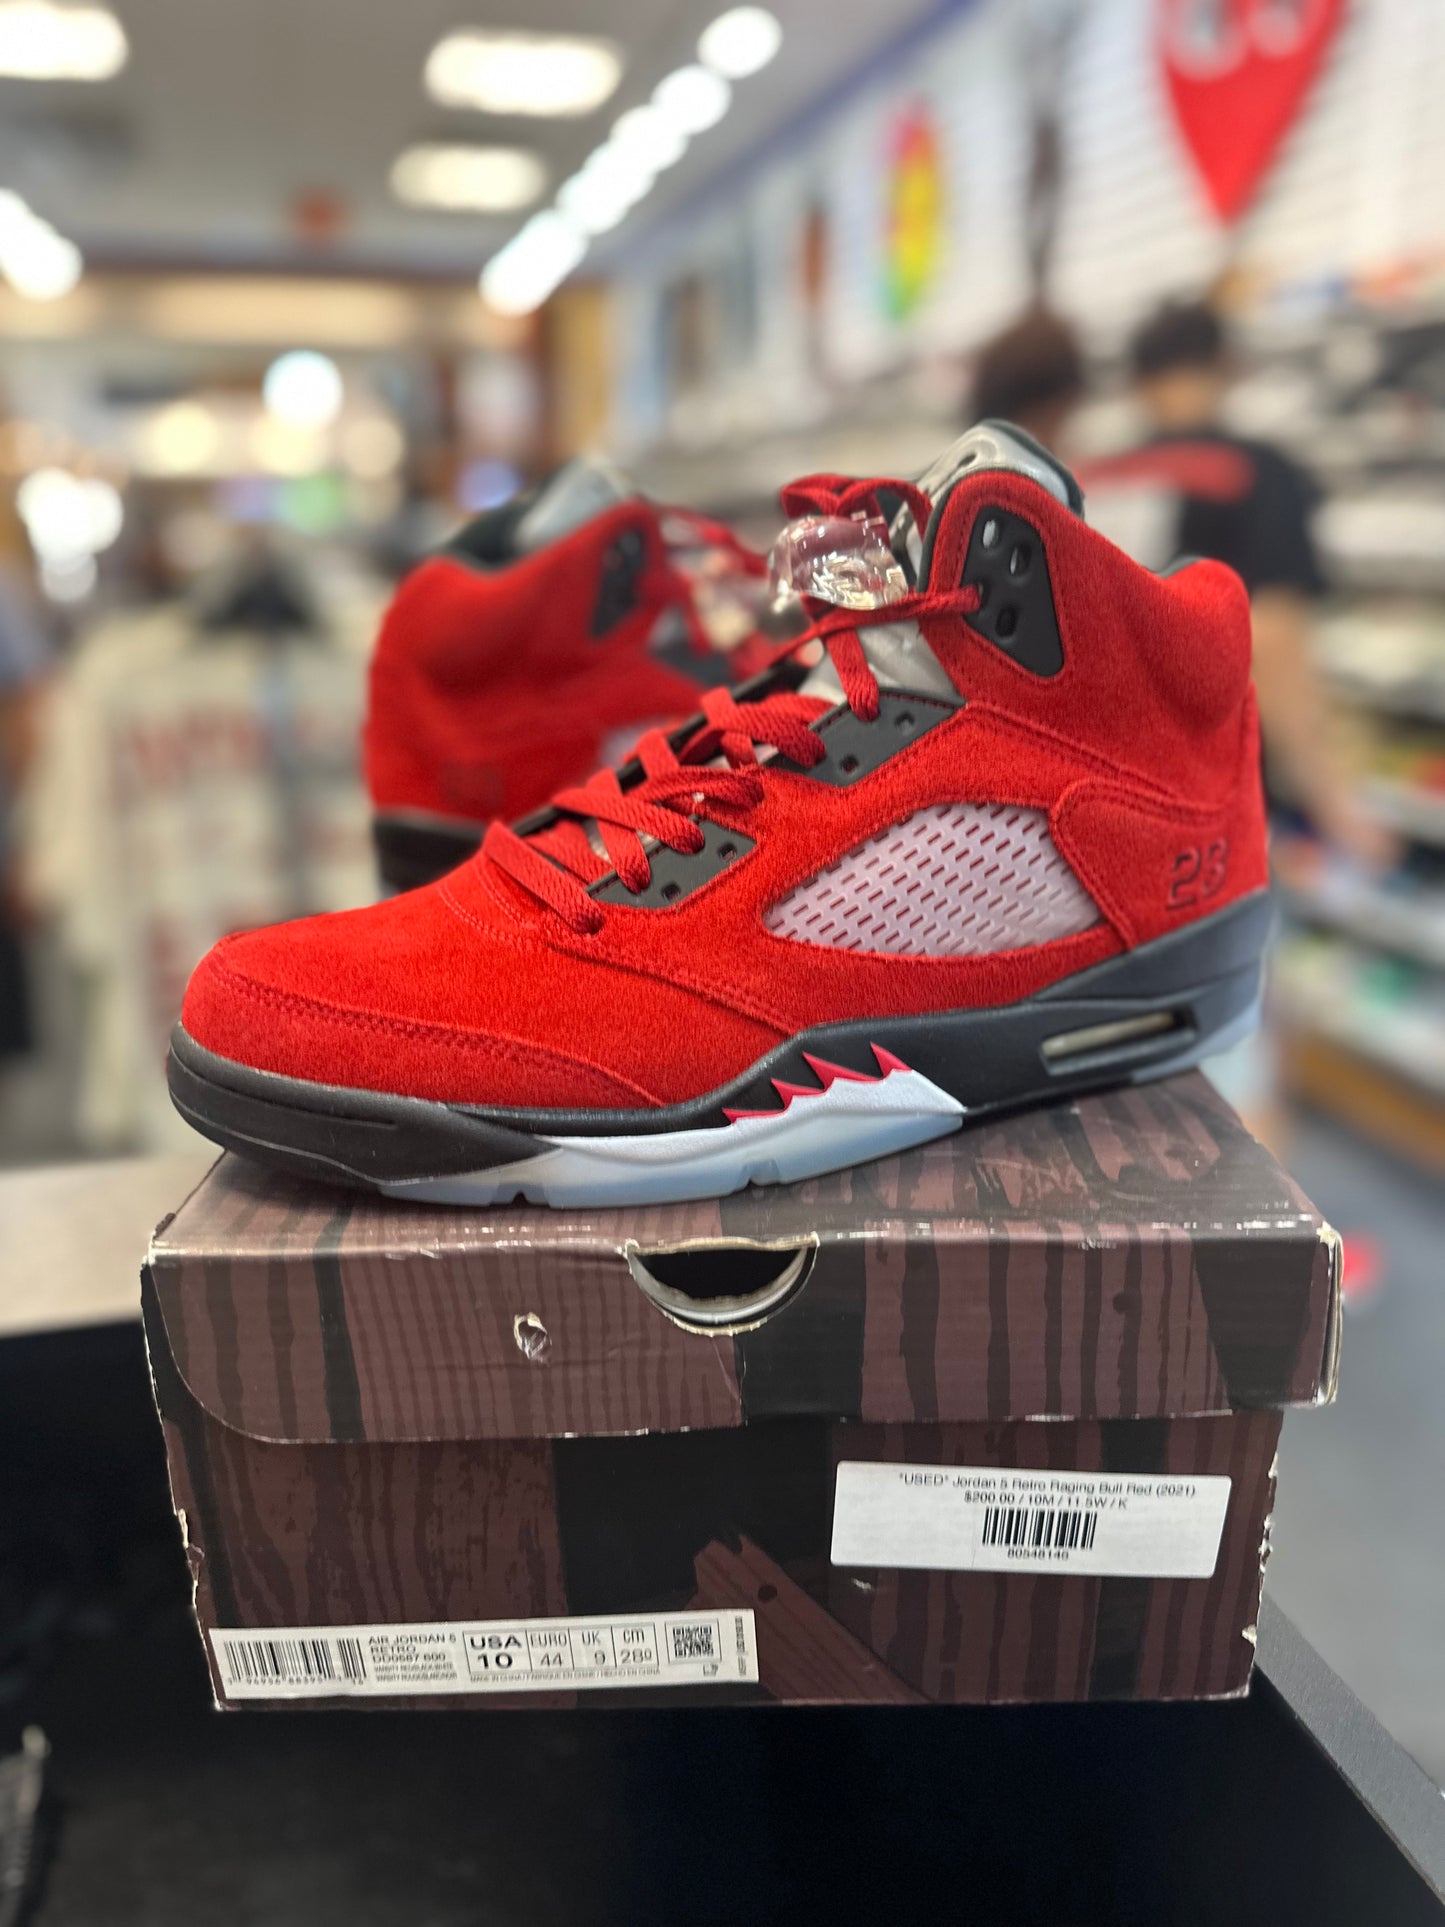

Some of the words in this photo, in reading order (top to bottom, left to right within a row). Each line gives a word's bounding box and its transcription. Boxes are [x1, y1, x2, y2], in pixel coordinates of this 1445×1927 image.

[1165, 839, 1228, 912] 23
[953, 1475, 996, 1488] Jordan
[1000, 1477, 1008, 1489] 5
[1012, 1478, 1046, 1492] Retro
[1050, 1479, 1095, 1494] Raging
[1100, 1481, 1123, 1495] Bull
[1127, 1482, 1151, 1496] Red
[1156, 1483, 1196, 1498] (2021)
[1028, 1493, 1054, 1507] 10M
[1118, 1497, 1128, 1510] K
[368, 1635, 389, 1645] AIR
[394, 1634, 446, 1646] JORDAN
[470, 1635, 522, 1650] USA
[530, 1632, 568, 1647] EURO
[582, 1631, 601, 1645] UK
[371, 1645, 416, 1655] RETRO
[477, 1652, 513, 1669] 10
[540, 1652, 563, 1667] 44
